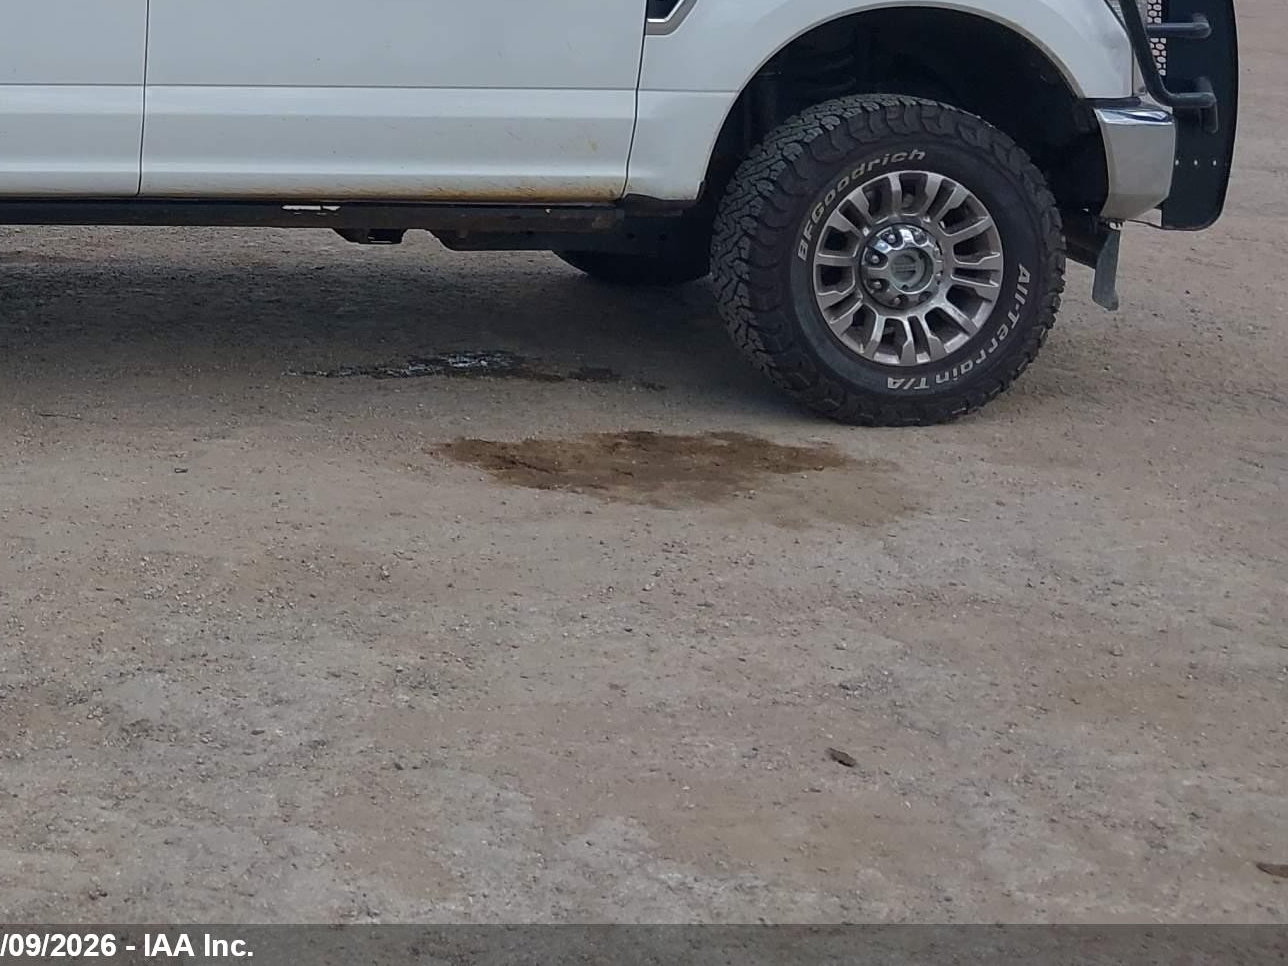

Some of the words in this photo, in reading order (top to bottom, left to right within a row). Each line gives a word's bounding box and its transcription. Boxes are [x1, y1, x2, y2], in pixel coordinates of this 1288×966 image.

[797, 149, 926, 261] BFGoodrich
[935, 263, 1031, 384] All-Terrain
[887, 377, 930, 390] T/A
